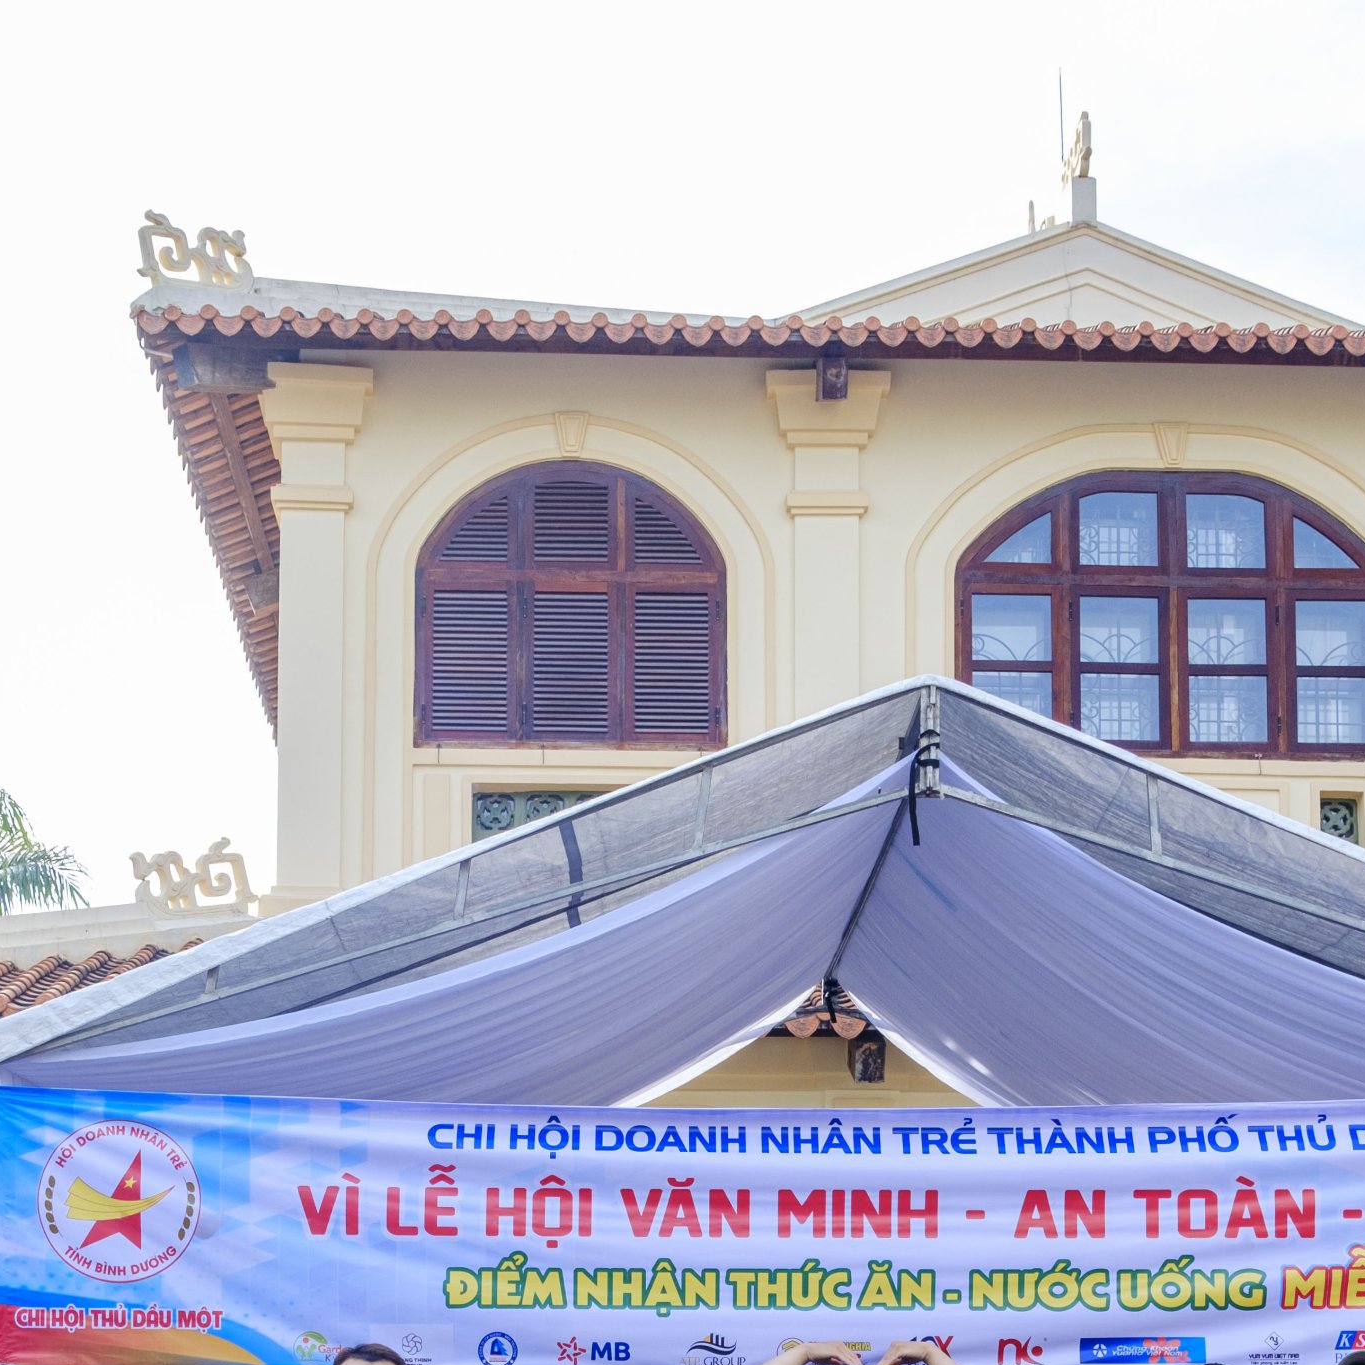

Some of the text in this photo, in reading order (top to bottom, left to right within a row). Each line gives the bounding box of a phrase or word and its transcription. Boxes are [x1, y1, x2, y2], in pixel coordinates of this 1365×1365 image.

[55, 1125, 190, 1172] HỘI DOANH NHÂN TRẺ
[427, 1123, 496, 1151] CHI
[510, 1115, 580, 1160] HỘI
[595, 1124, 747, 1154] DOANH
[761, 1118, 882, 1155] NHÂN
[892, 1117, 978, 1155] TRẺ
[987, 1116, 1135, 1155] THÀNH
[1148, 1114, 1240, 1153] PHỐ
[1248, 1114, 1336, 1152] THỦ
[297, 1172, 360, 1236] VÌ
[387, 1164, 458, 1236] LỄ
[486, 1174, 592, 1249] HỘI
[620, 1177, 752, 1238] VĂN
[778, 1190, 939, 1239] MINH
[1014, 1189, 1107, 1239] AN
[1133, 1176, 1317, 1239] TOÀN
[65, 1243, 180, 1278] TỈNH BÌNH DƯƠNG
[443, 1250, 568, 1311] ĐIỂM
[572, 1258, 721, 1317] NHẬN
[728, 1258, 853, 1311] THỨC
[858, 1261, 937, 1312] ĂN
[968, 1258, 1112, 1312] NƯỚC
[1117, 1255, 1268, 1312] UỐNG
[15, 1302, 224, 1334] CHI HỘI THỦ DẦU MỘT
[591, 1342, 631, 1362] MB
